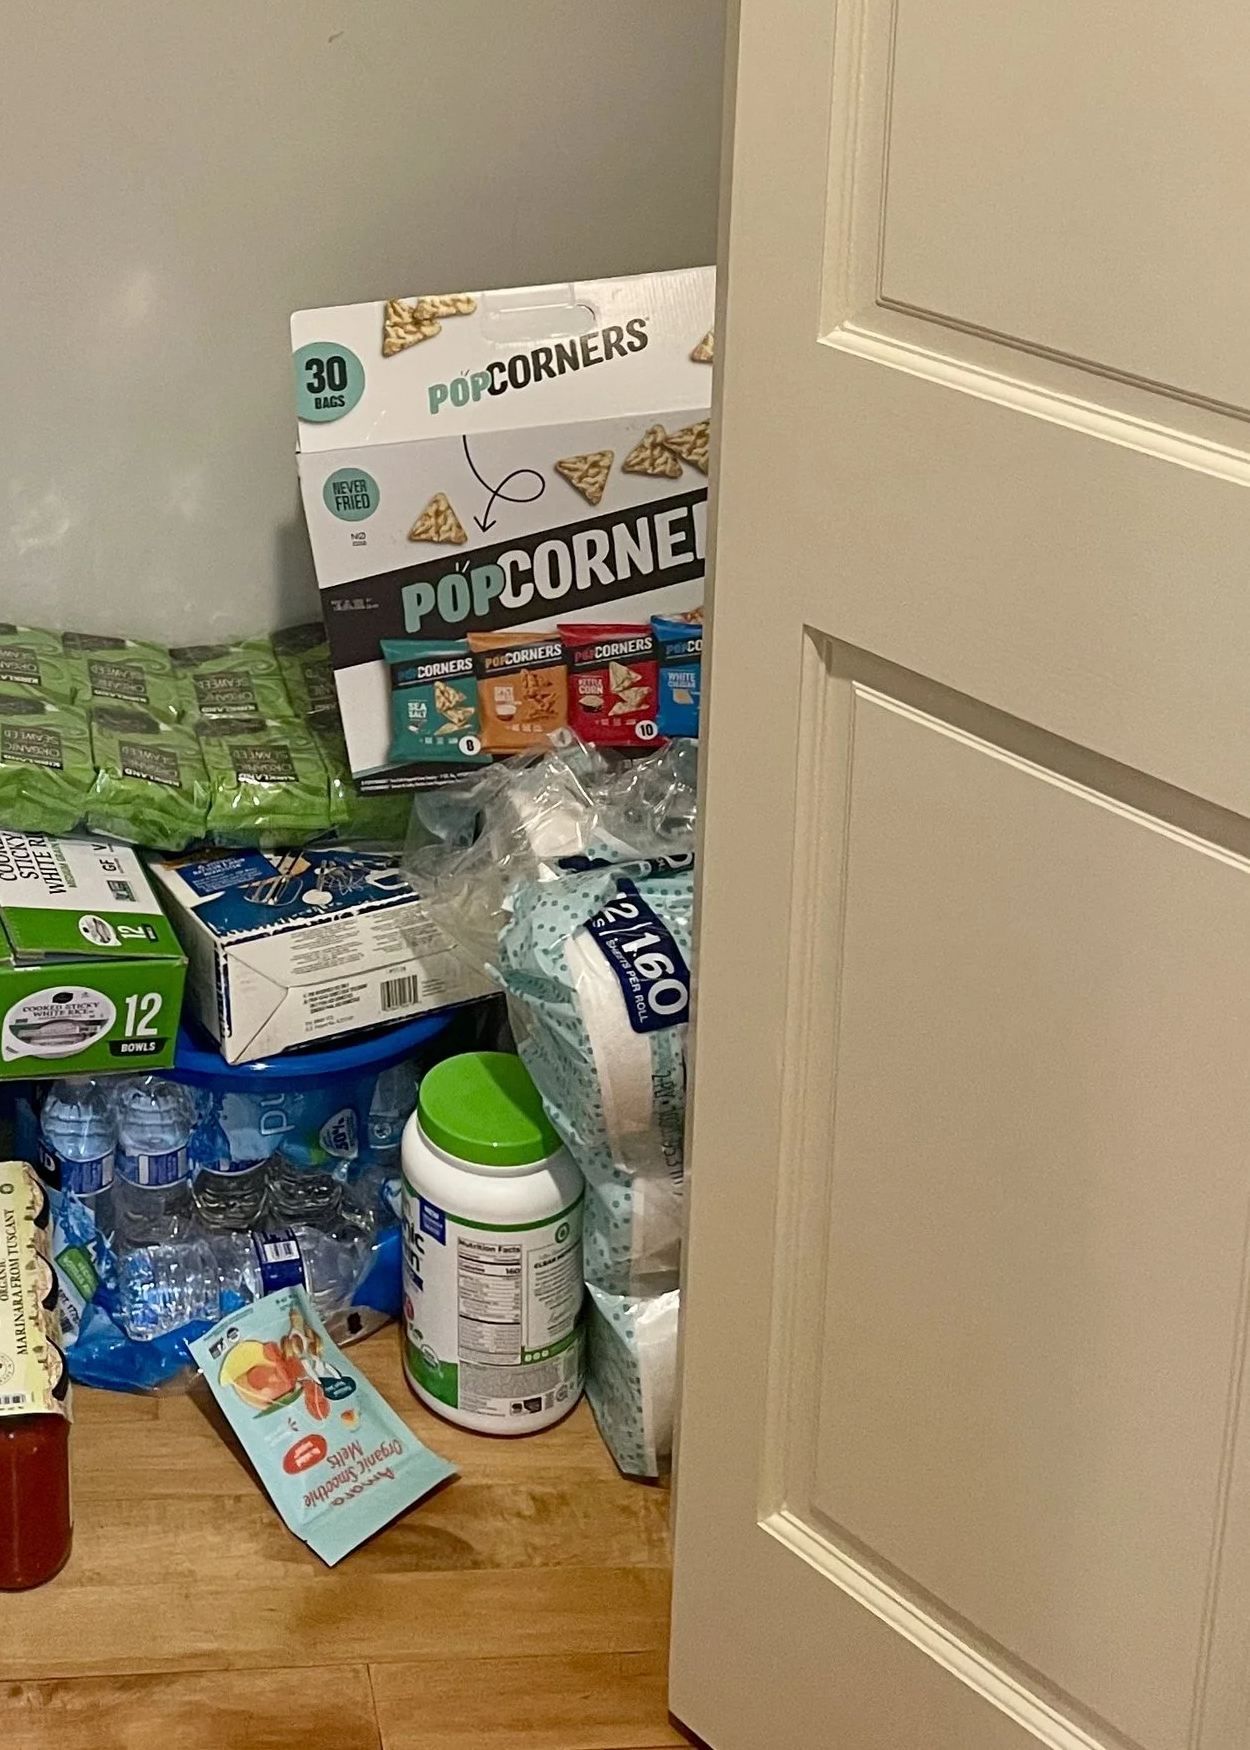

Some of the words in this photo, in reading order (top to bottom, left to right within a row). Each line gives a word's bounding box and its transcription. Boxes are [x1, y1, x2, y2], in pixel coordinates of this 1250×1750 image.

[304, 355, 348, 395] 30
[427, 317, 650, 416] POPCORNERS
[314, 394, 347, 411] BAGS
[332, 479, 368, 496] NEVER
[335, 493, 371, 512] FRIED
[484, 642, 563, 669] POPCORNERS
[574, 636, 654, 663] POPCORNERS
[578, 685, 604, 696] CORN
[667, 672, 697, 682] WHITE
[407, 702, 427, 712] SEA
[407, 710, 428, 720] SALT
[638, 722, 654, 738] 10
[1, 831, 40, 881] STICKY
[101, 857, 118, 872] GF
[32, 850, 67, 895] WHITE
[120, 924, 145, 939] 12
[621, 931, 689, 1016] 160
[627, 969, 643, 996] PER
[33, 1010, 66, 1018] WHITE
[64, 1001, 100, 1010] STICKY
[124, 991, 164, 1038] 12
[634, 995, 649, 1024] ROLL
[120, 1041, 157, 1053] BOWLS
[2, 1208, 19, 1257] TUSCANY
[458, 1238, 496, 1253] Nutrition
[497, 1244, 521, 1253] Facts
[0, 1257, 9, 1303] ORGANIC
[9, 1255, 23, 1293] FROM
[13, 1292, 29, 1356] MARINARA
[325, 1438, 364, 1470] Melts
[356, 1438, 404, 1475] Organic
[302, 1465, 359, 1509] Smoothie
[330, 1467, 396, 1507] Amara
